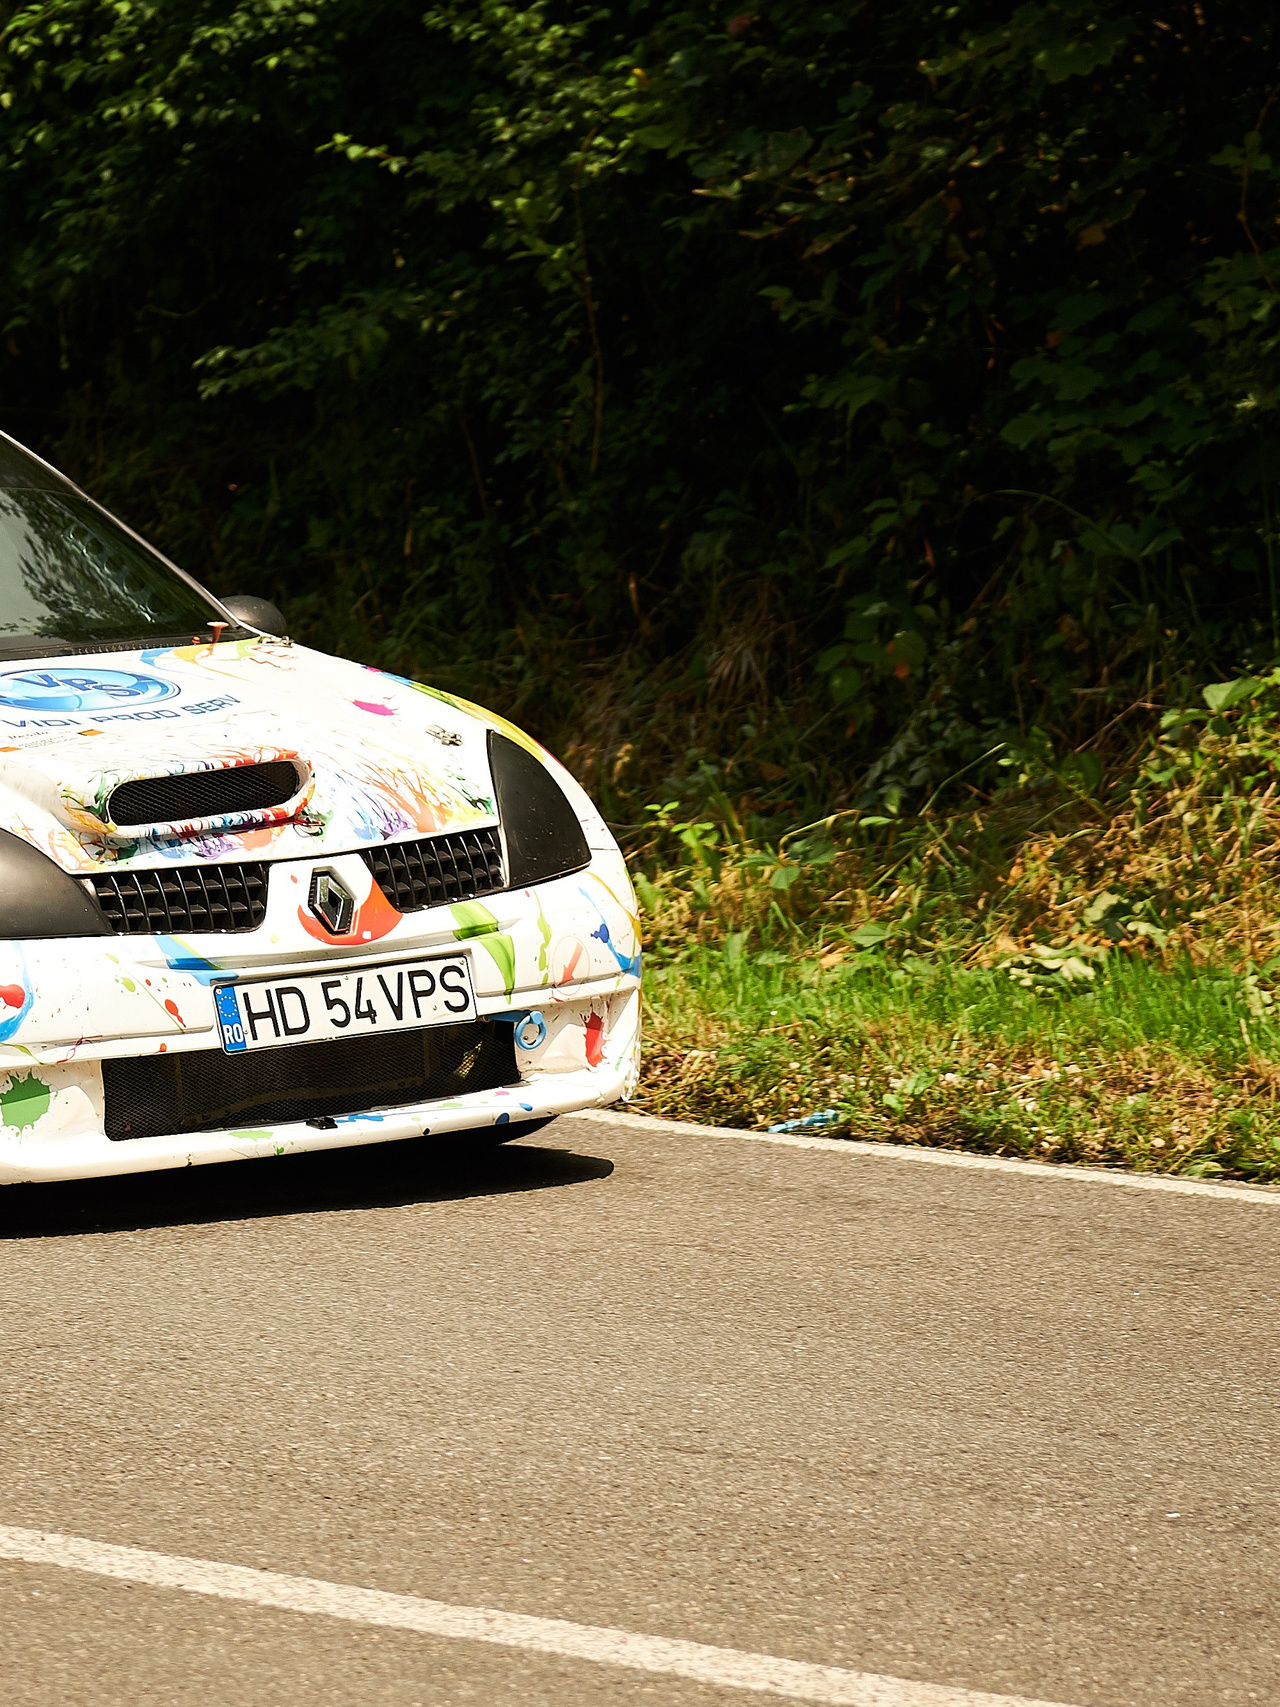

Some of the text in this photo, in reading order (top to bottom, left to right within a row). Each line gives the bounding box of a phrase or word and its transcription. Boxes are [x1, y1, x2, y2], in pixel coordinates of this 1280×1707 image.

[10, 674, 142, 697] VPS
[181, 693, 241, 715] SERV
[243, 986, 311, 1041] HD
[223, 1022, 244, 1045] RO
